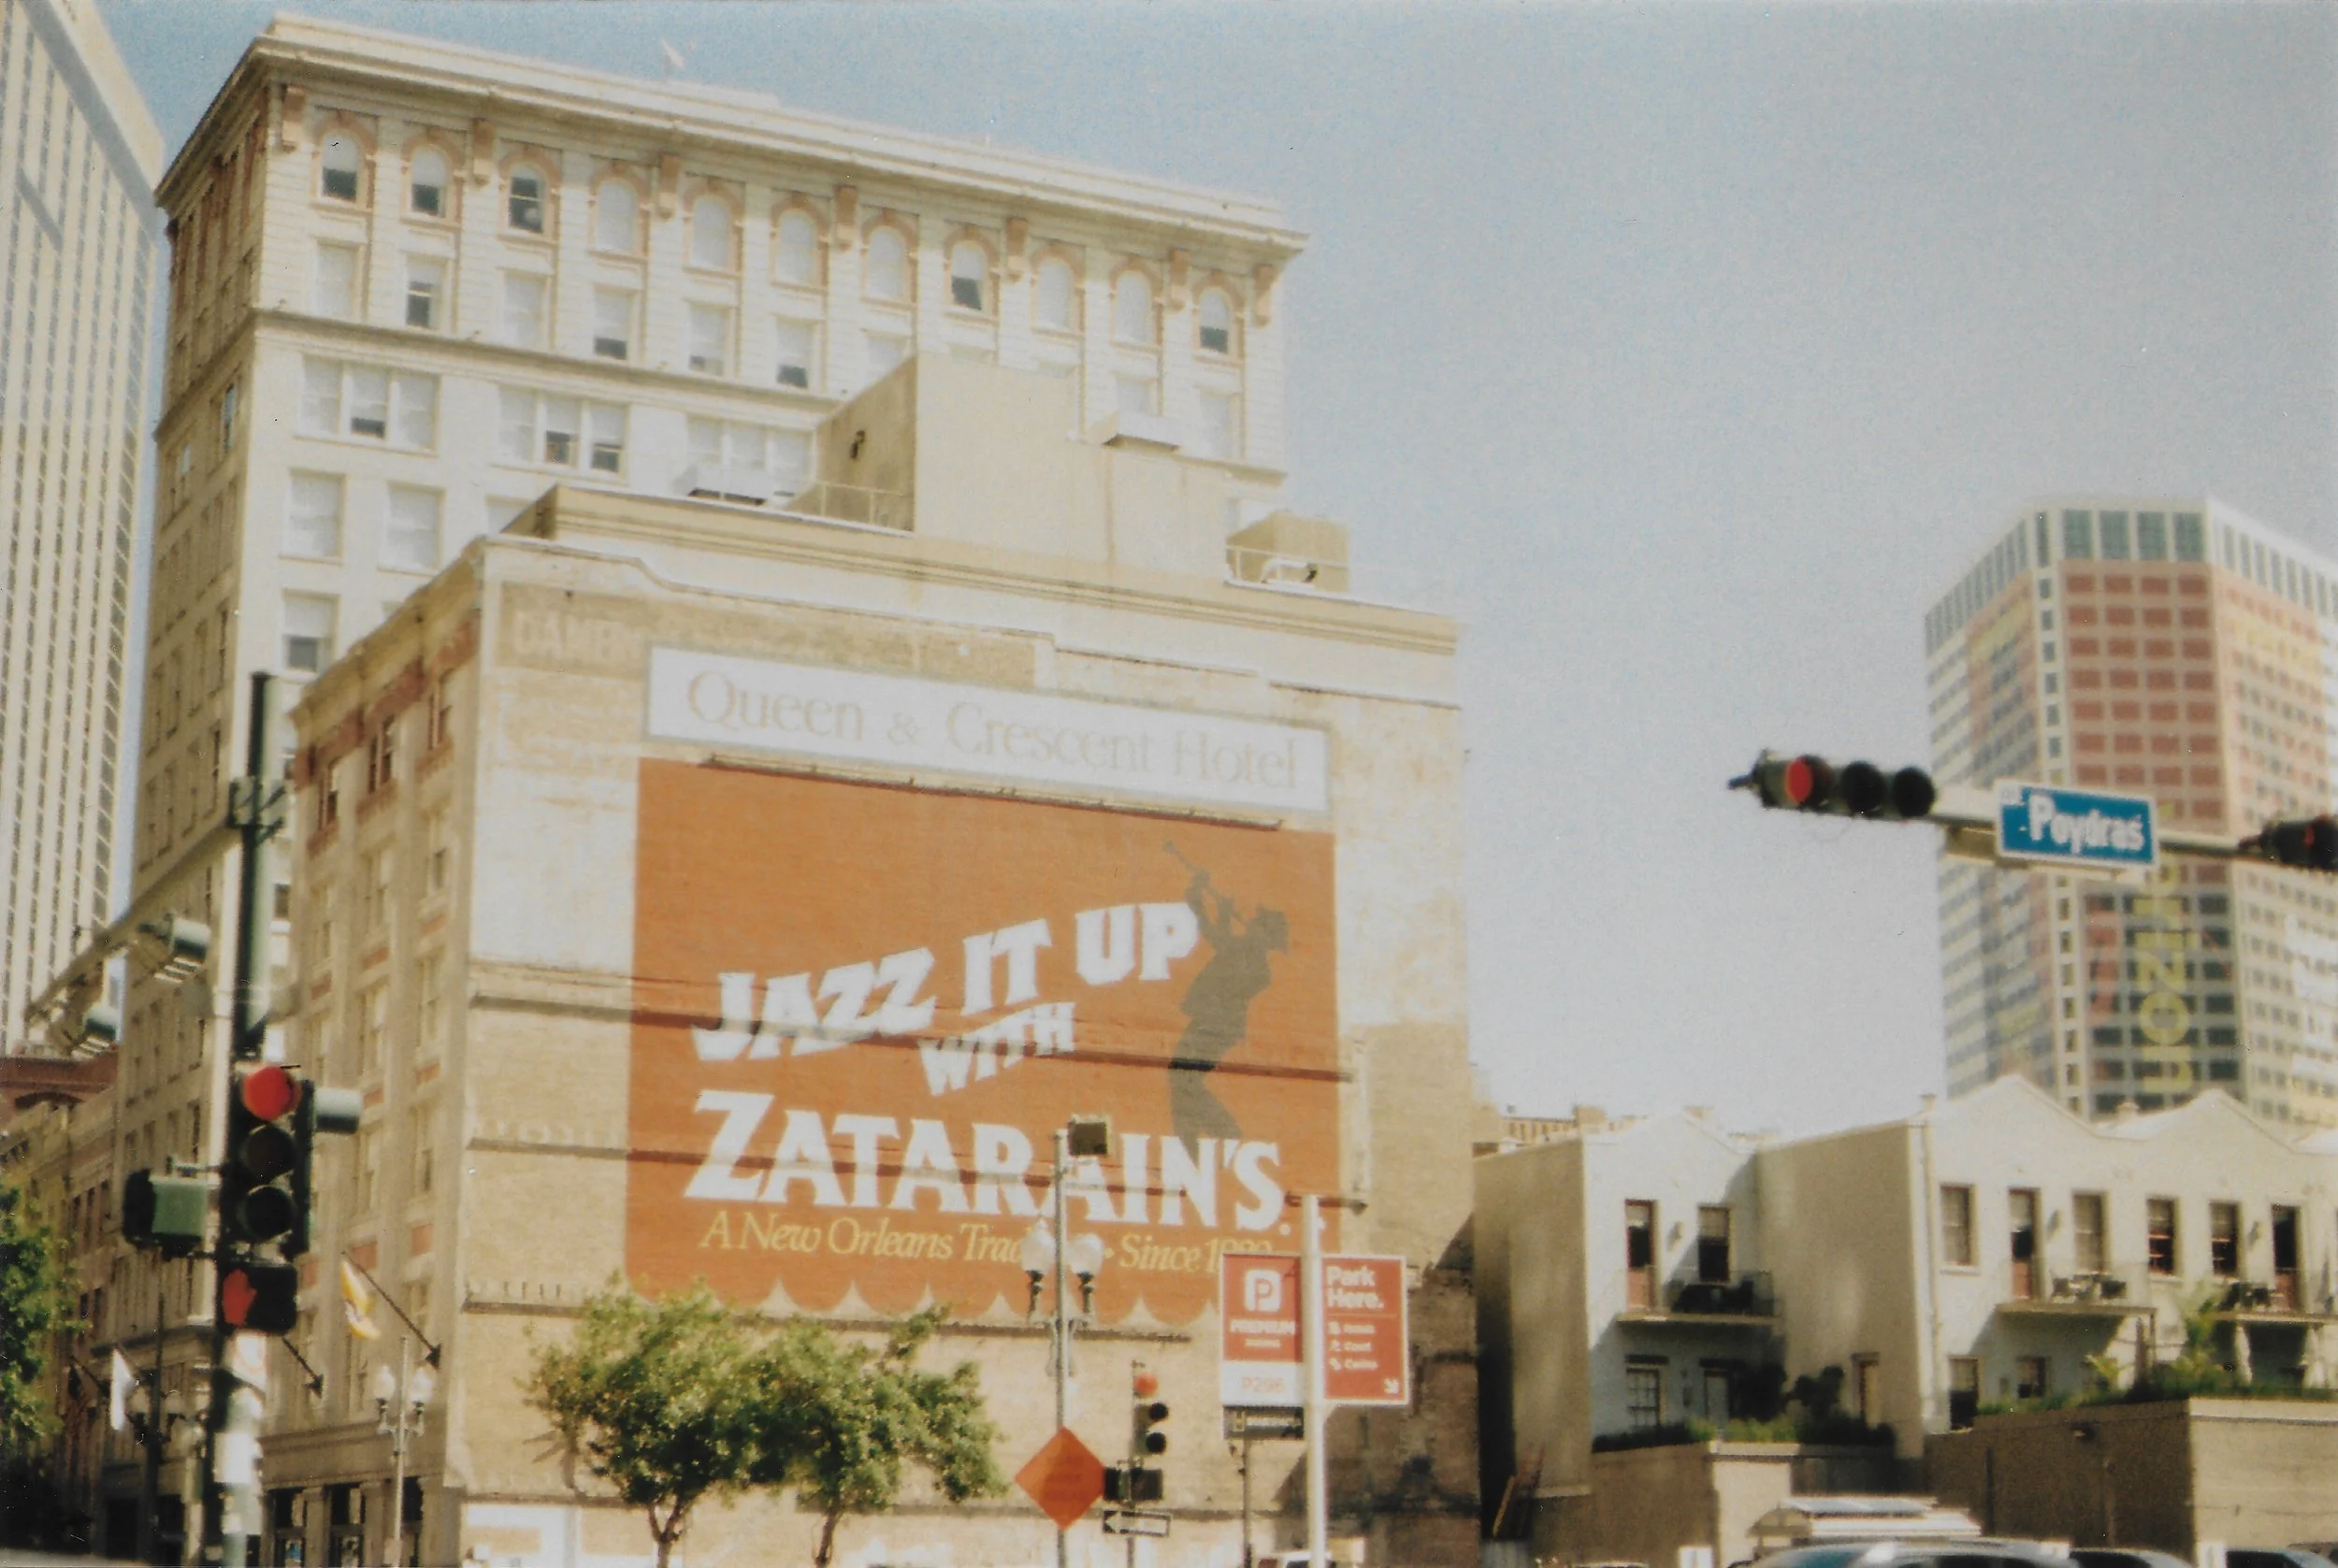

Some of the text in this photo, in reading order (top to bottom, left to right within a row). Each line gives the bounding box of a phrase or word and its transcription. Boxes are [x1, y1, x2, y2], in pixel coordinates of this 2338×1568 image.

[687, 670, 1298, 789] Queen & Crescent Hotel
[690, 903, 1201, 1061] JAZZ IT UP
[917, 1001, 1076, 1096] WITH
[700, 1211, 733, 1249] A
[740, 1212, 822, 1253] New
[828, 1216, 953, 1260] Orleans
[1119, 1233, 1201, 1273] Since
[1326, 1266, 1376, 1287] Park
